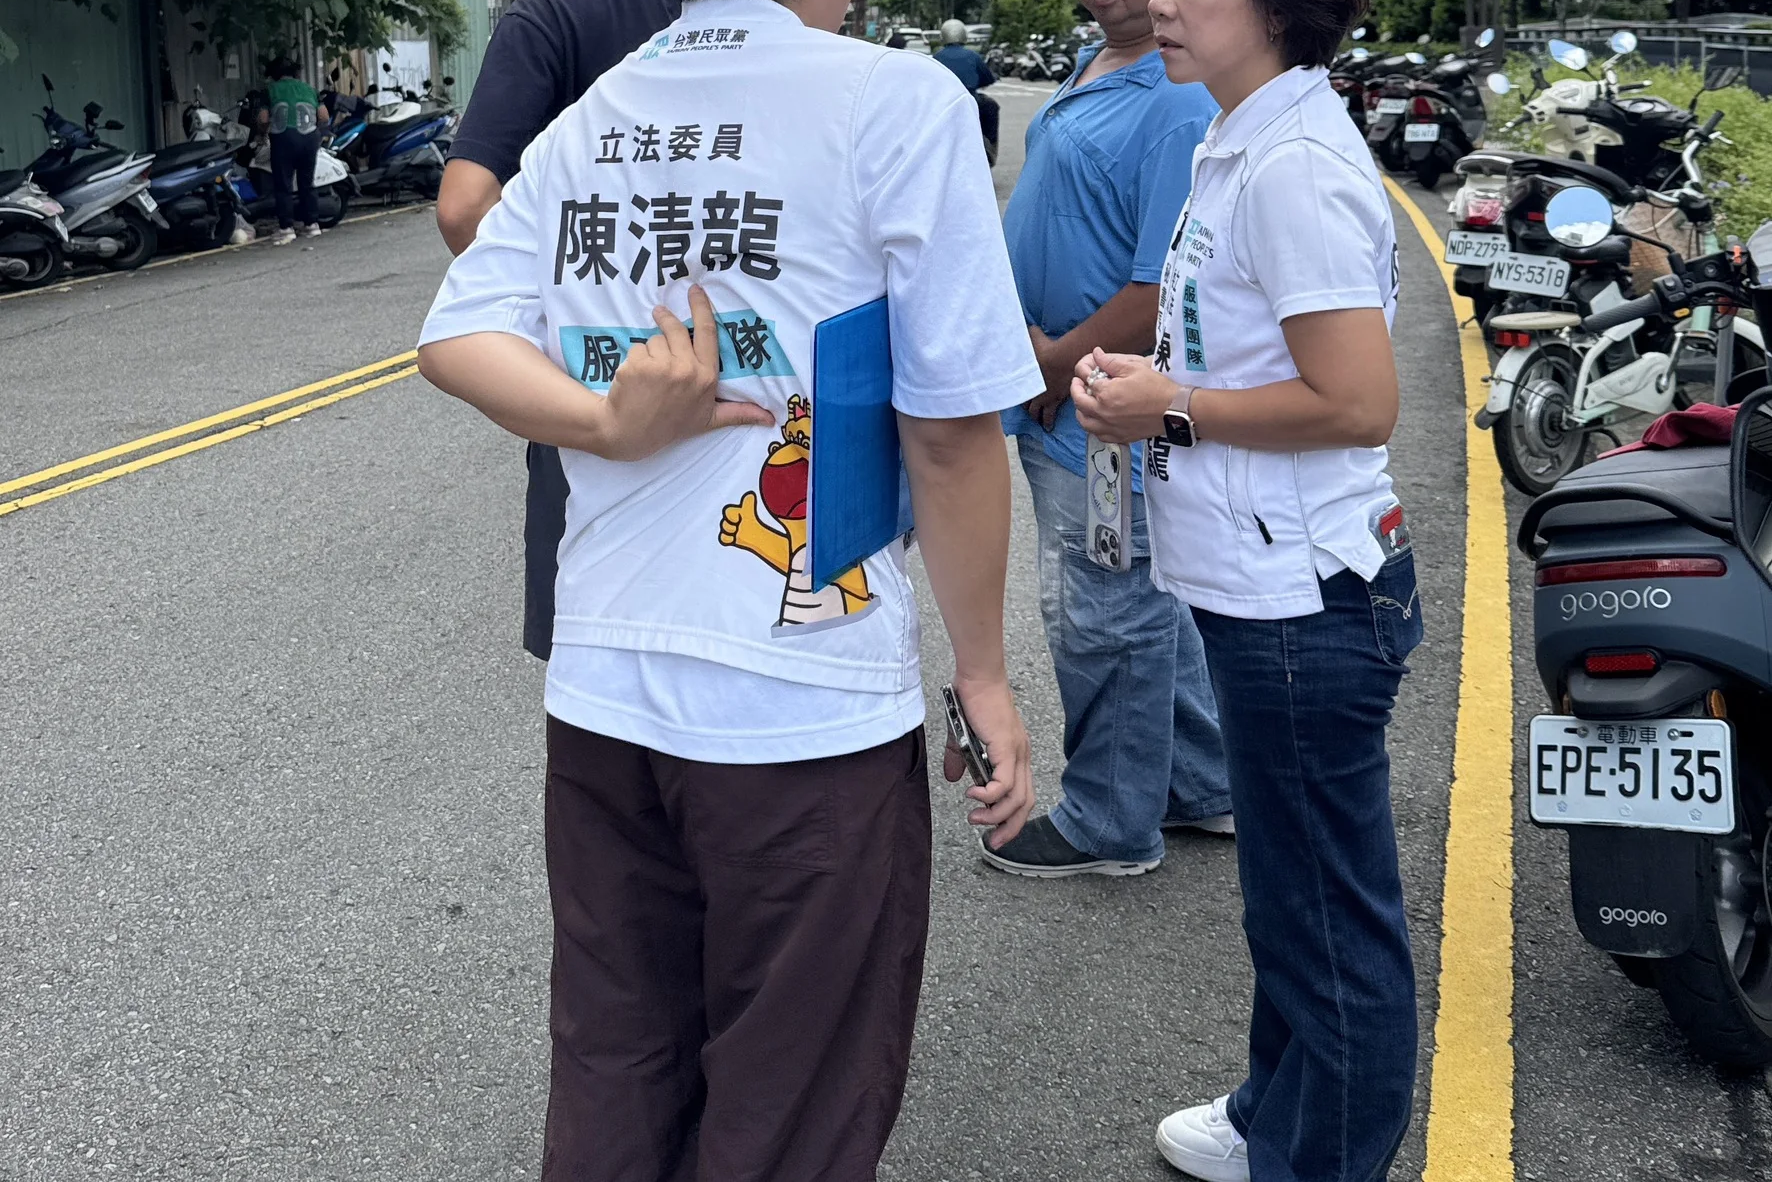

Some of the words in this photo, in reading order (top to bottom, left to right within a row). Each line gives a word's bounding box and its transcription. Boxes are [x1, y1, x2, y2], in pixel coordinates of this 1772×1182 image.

[673, 28, 750, 49] 台灣民眾黨
[595, 124, 744, 164] 立法委員
[554, 190, 784, 286] 陳清龍
[1186, 252, 1202, 268] PARTY
[1183, 284, 1204, 365] 服務團隊
[581, 316, 772, 382] 服隊
[1560, 585, 1672, 621] gogoro
[1597, 724, 1658, 745] 電動車
[1599, 906, 1668, 927] gogoro
